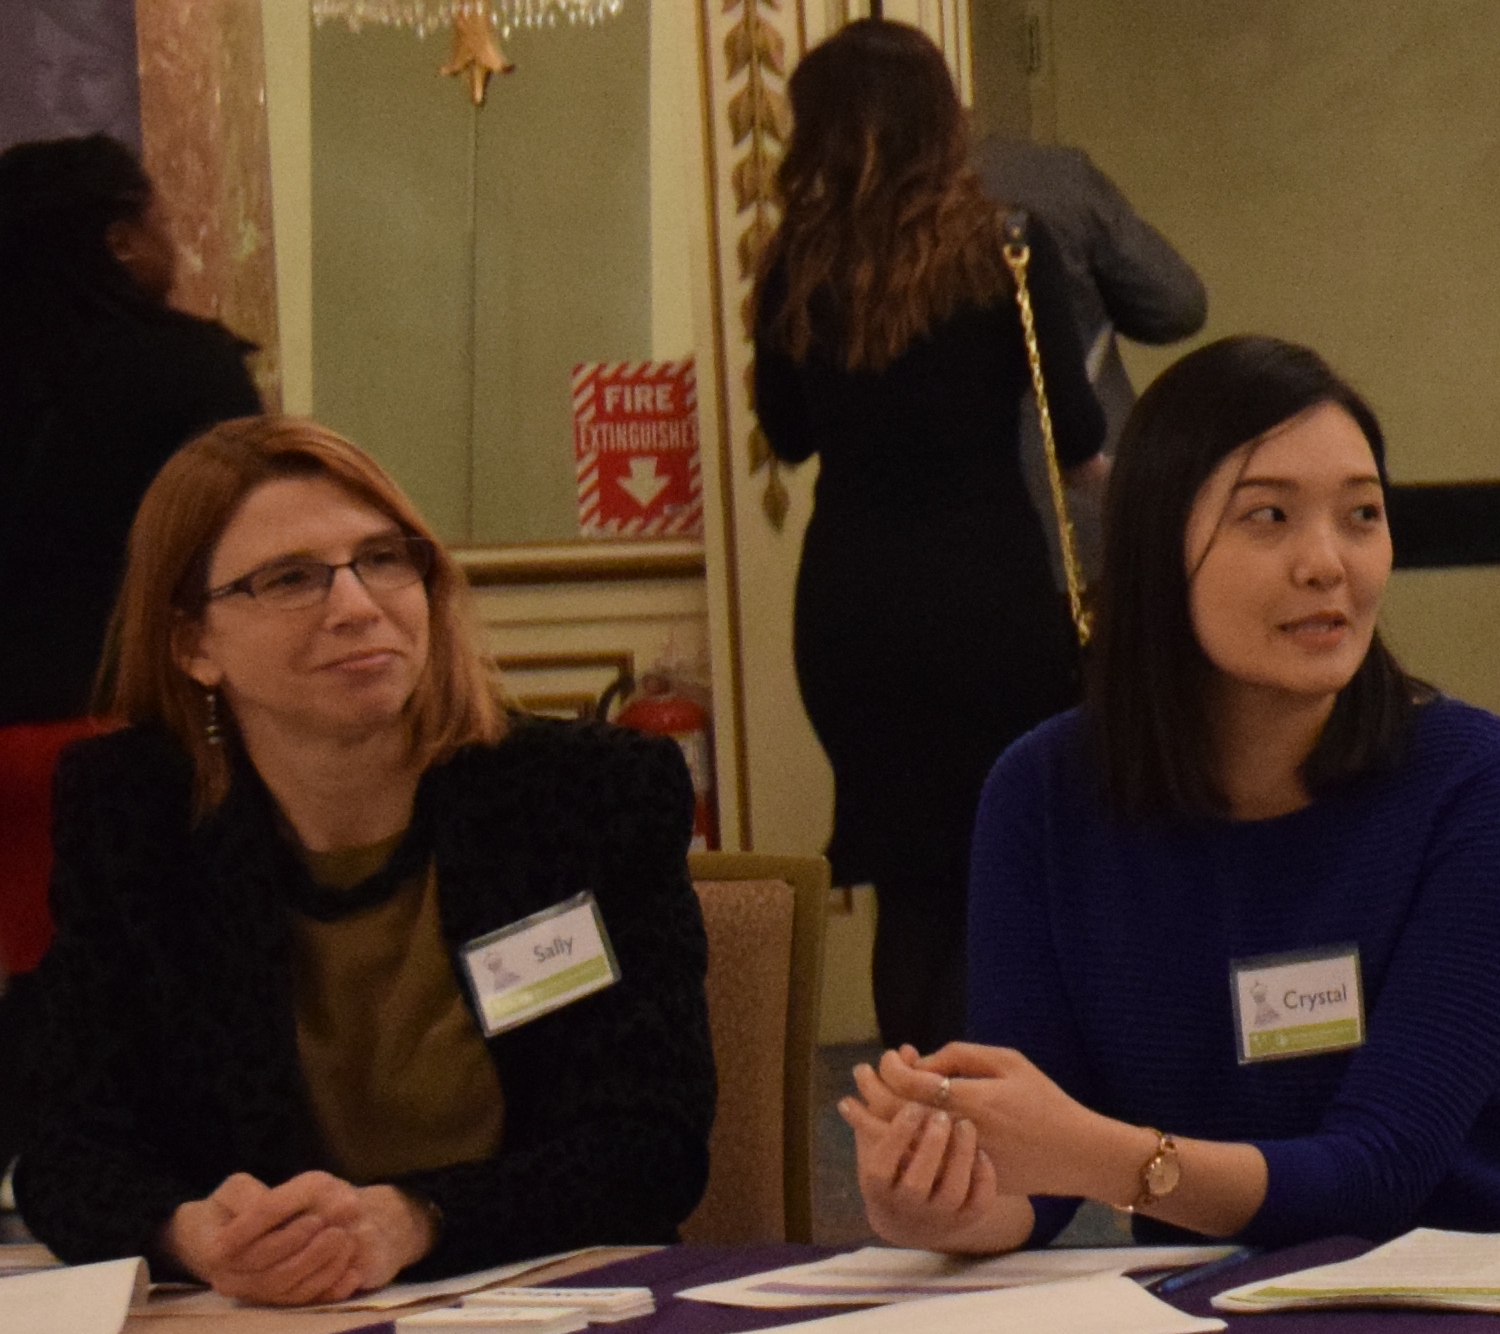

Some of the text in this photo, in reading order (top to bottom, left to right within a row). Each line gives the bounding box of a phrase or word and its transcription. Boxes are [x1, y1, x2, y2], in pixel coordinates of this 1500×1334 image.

[604, 383, 674, 413] FIRE
[533, 934, 573, 964] Sally
[1283, 983, 1347, 1012] Crystal
